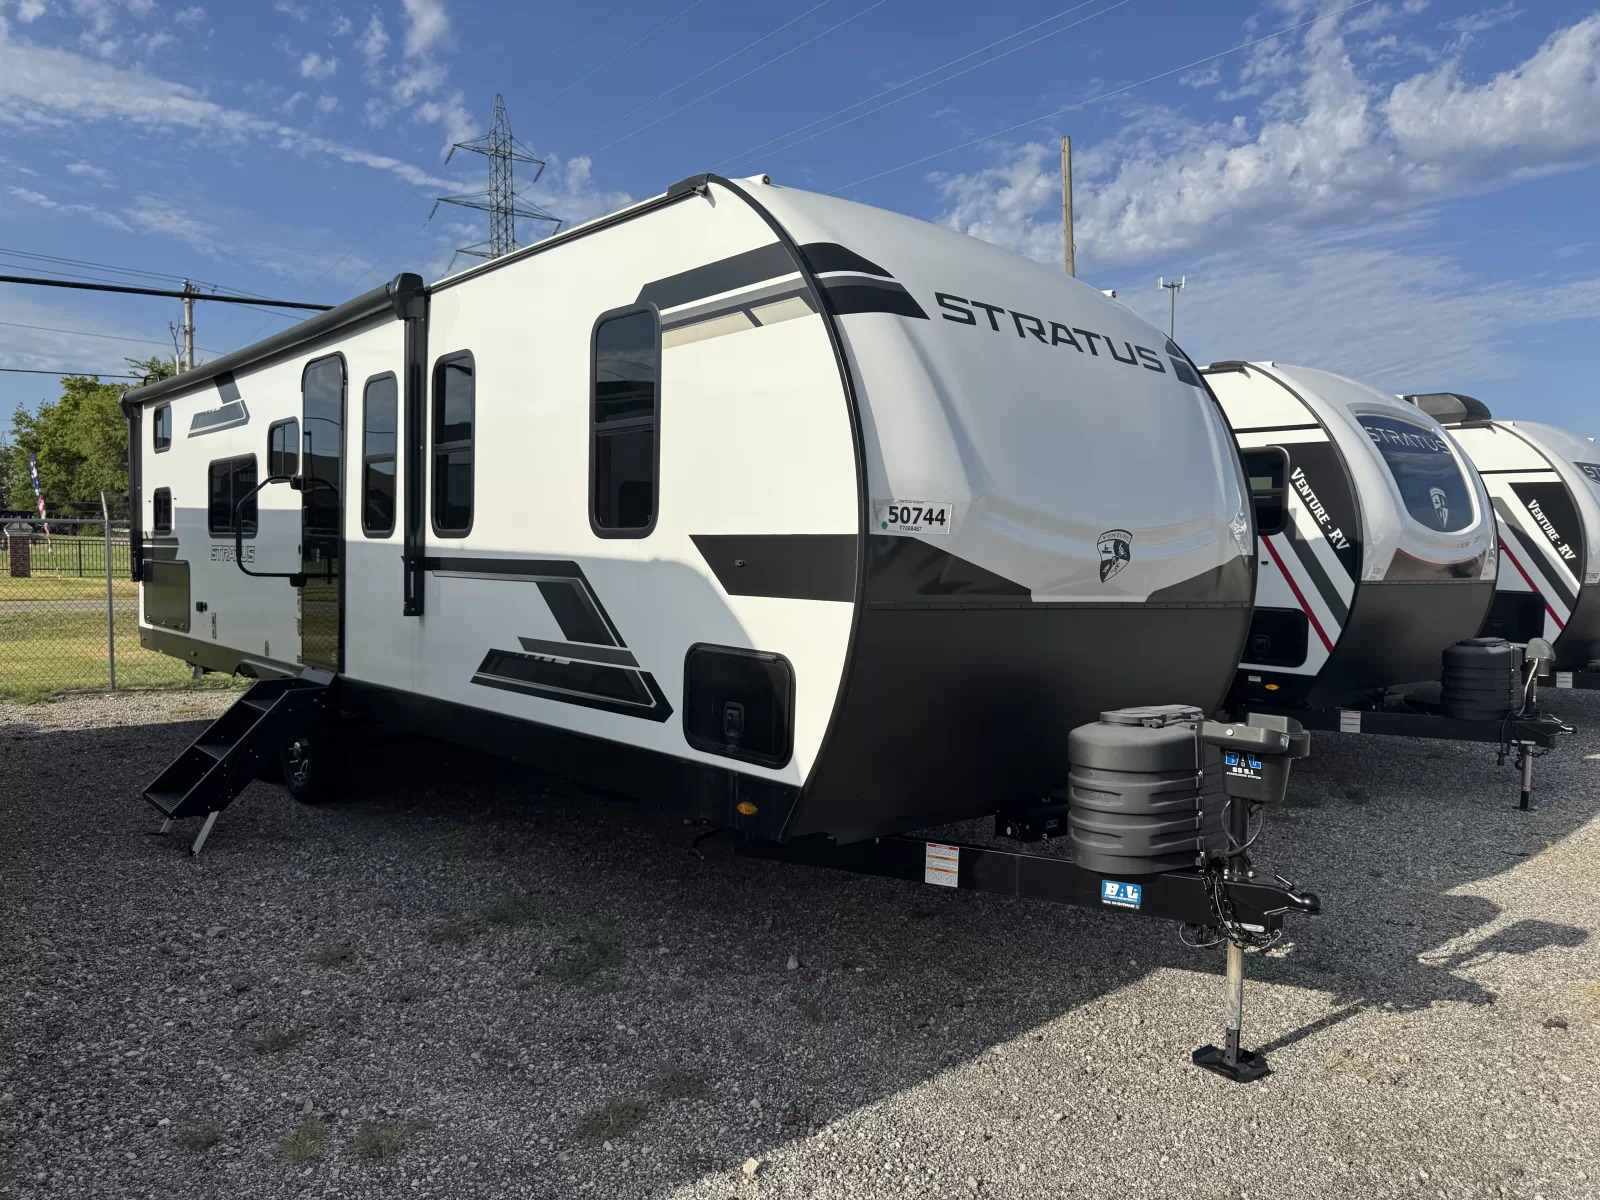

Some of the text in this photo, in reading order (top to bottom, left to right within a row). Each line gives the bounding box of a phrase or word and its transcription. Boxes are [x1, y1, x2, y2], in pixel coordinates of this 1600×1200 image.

[934, 292, 1166, 373] STRATUS
[1364, 426, 1451, 455] STRATUS
[1583, 466, 1600, 478] ST
[888, 505, 946, 526] 50744
[1291, 467, 1330, 525] VENTURE
[1328, 528, 1350, 550] RV
[1528, 499, 1560, 542] VENTURE
[1558, 543, 1576, 560] RV
[211, 544, 255, 563] STRAUS
